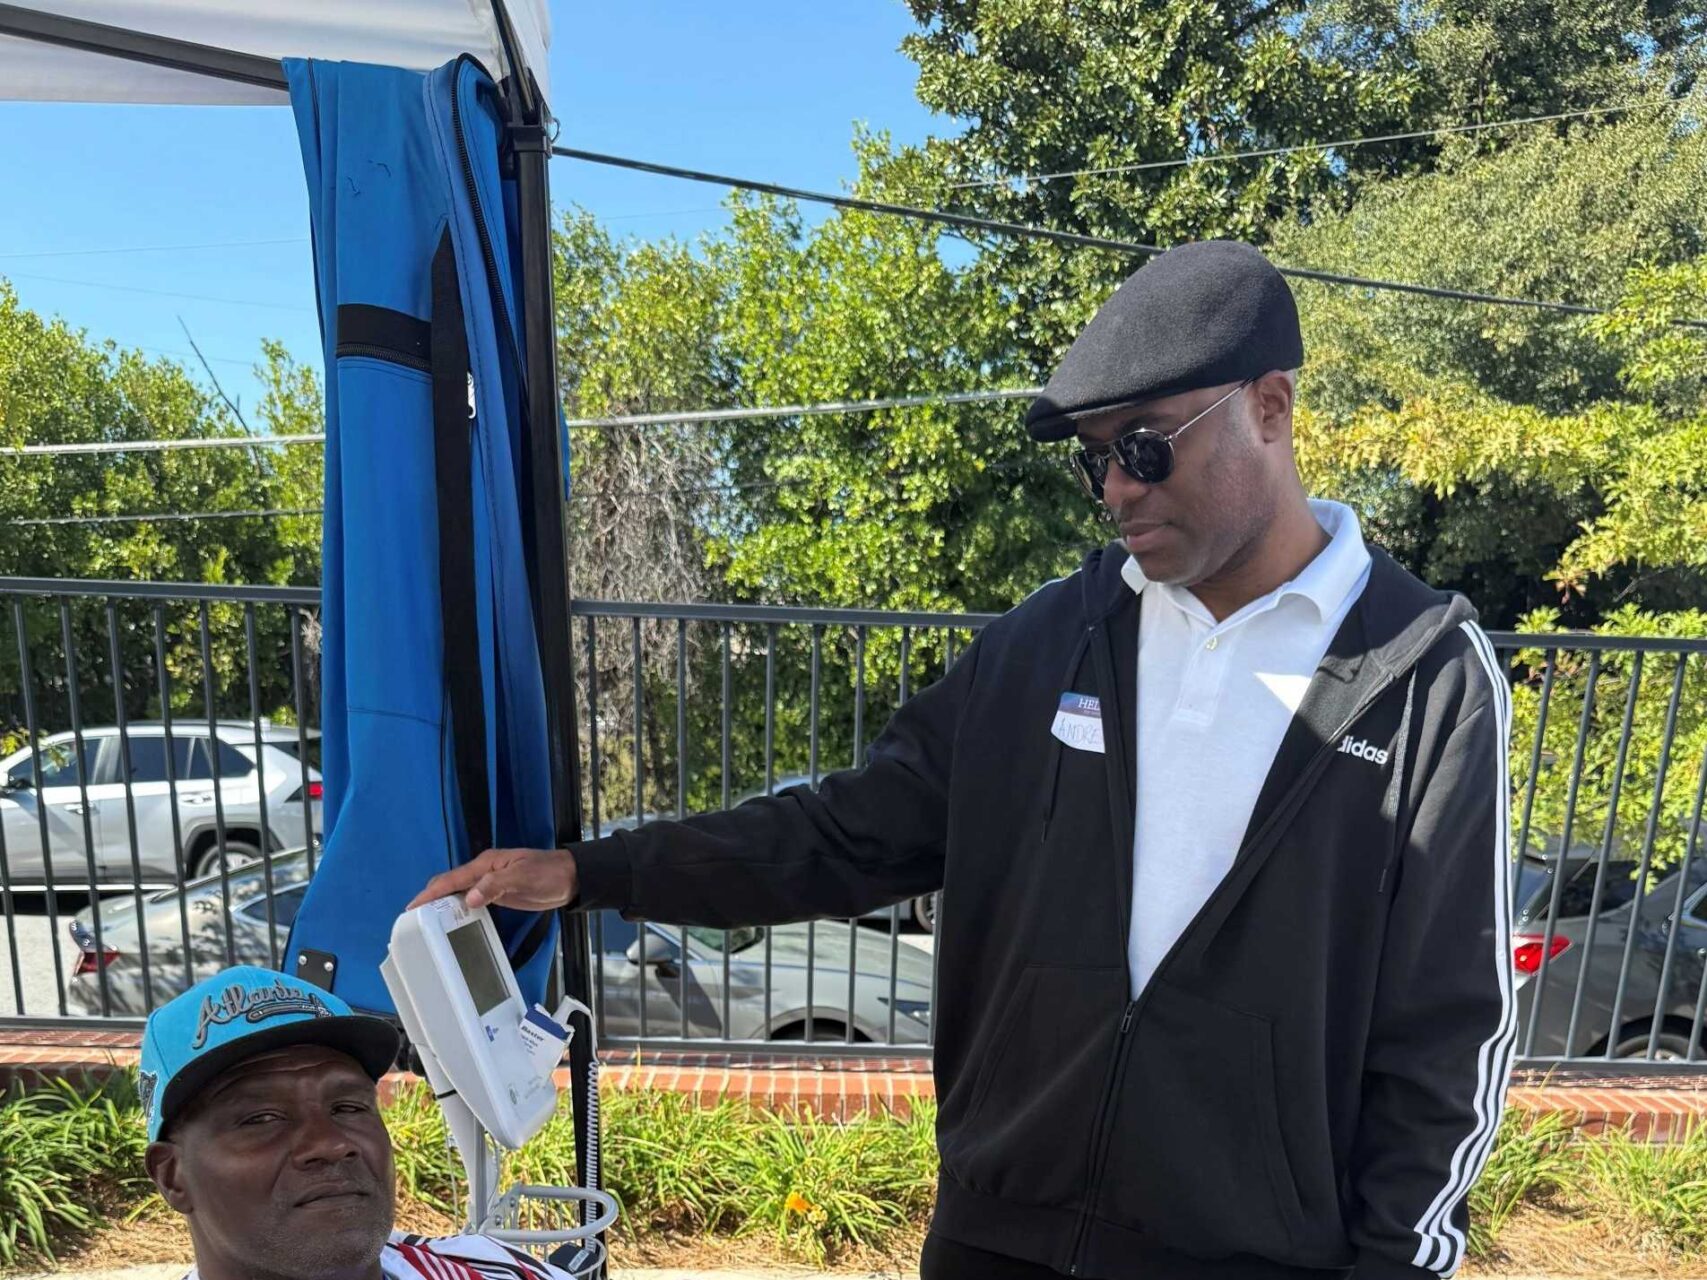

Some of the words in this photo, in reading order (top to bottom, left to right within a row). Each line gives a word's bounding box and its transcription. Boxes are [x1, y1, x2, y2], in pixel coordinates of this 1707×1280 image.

[1078, 697, 1100, 711] HEL
[1336, 735, 1389, 765] didas
[191, 977, 305, 1050] Atlanta
